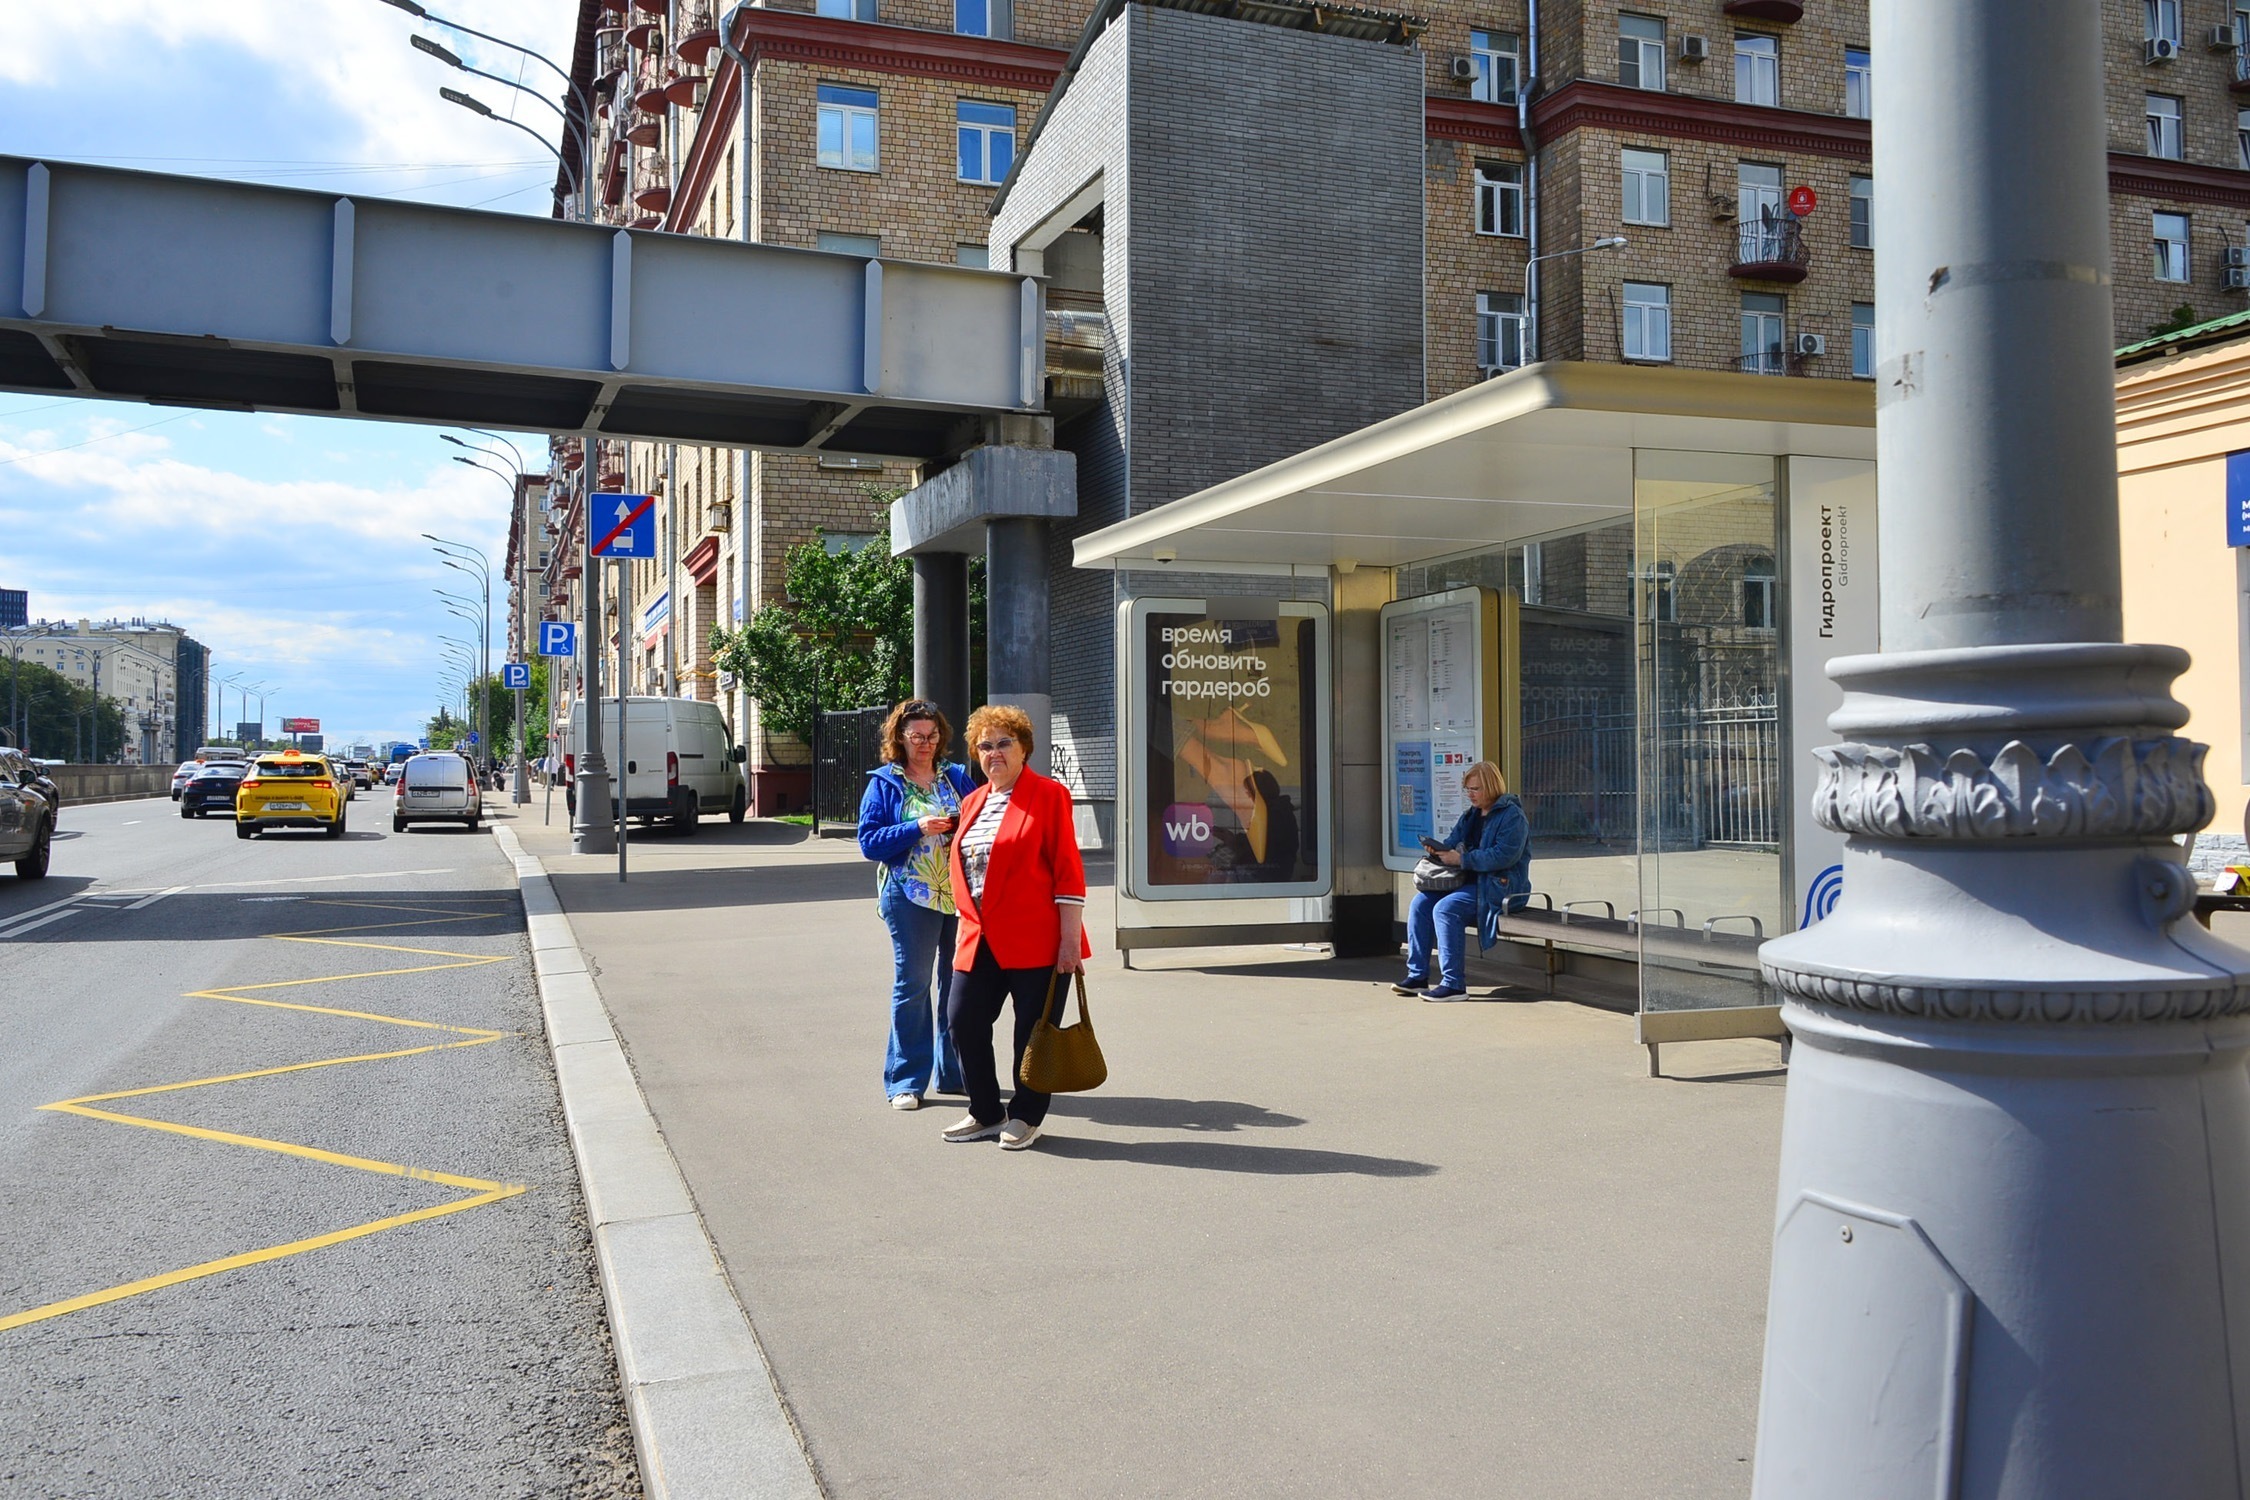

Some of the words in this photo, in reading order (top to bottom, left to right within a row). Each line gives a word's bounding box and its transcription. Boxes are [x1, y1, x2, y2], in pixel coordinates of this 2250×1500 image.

[1837, 505, 1849, 587] Gidroproekt
[1819, 504, 1836, 639] Гидропроект
[546, 624, 569, 653] P
[1161, 627, 1232, 647] время
[1161, 648, 1267, 671] обновить
[510, 666, 526, 686] P
[1161, 676, 1271, 701] гардероб
[1165, 813, 1210, 842] wb
